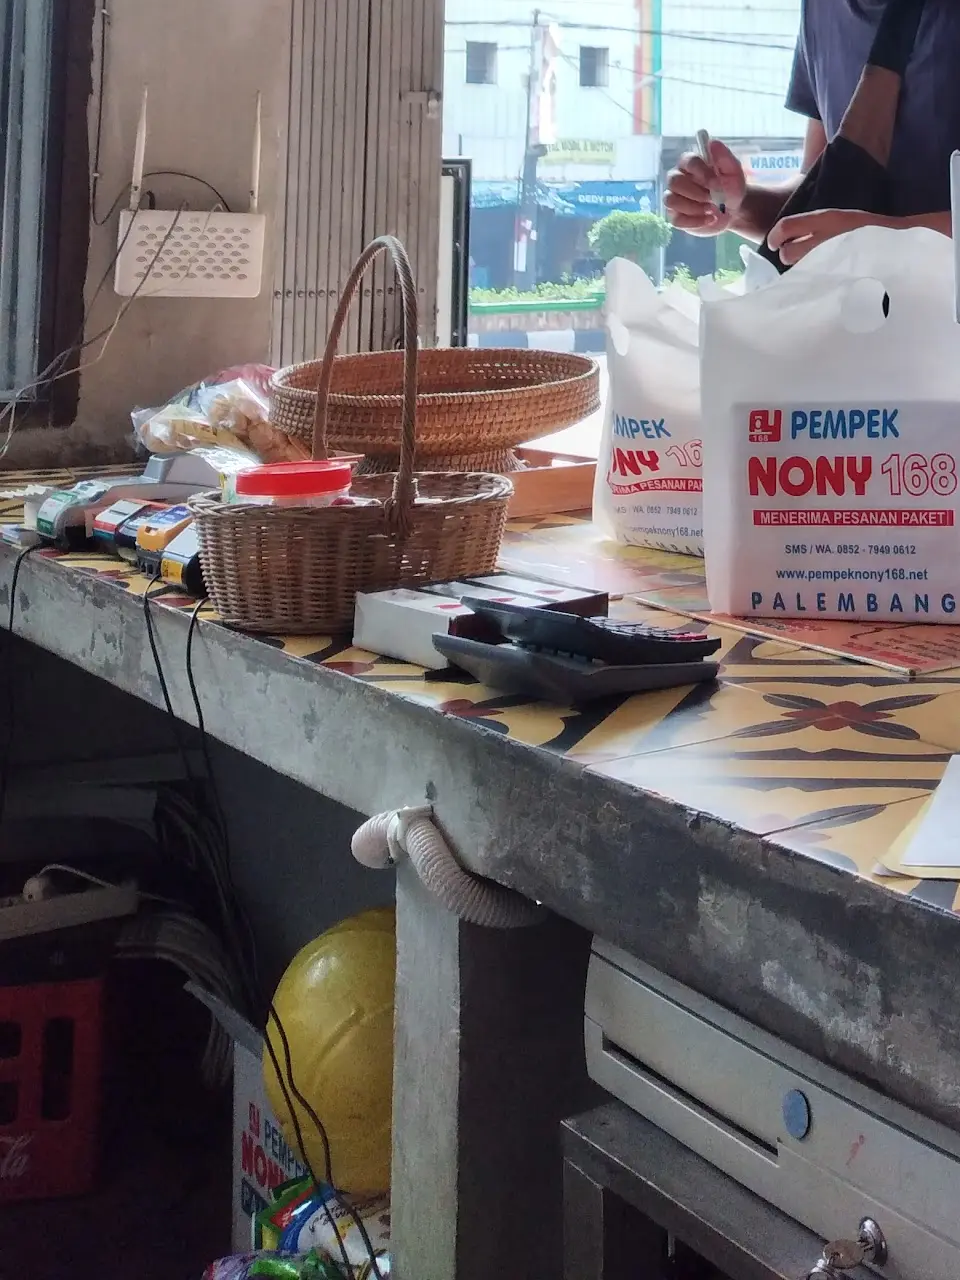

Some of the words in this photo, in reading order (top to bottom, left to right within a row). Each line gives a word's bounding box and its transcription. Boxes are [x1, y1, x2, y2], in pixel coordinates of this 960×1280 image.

[612, 410, 672, 439] MPEK
[791, 409, 900, 440] PEMPEK
[612, 447, 660, 477] NY
[665, 439, 703, 468] 16
[748, 456, 872, 497] NONY
[881, 453, 958, 496] 168
[640, 480, 686, 492] PESANAN
[760, 511, 831, 524] MENERIMA
[834, 511, 898, 524] PESANAN
[901, 511, 946, 524] PAKET
[785, 545, 807, 554] SMS
[815, 545, 834, 554] WA.
[837, 545, 860, 555] 0852
[868, 545, 891, 555] 7949
[893, 545, 917, 555] 0612
[776, 568, 928, 582] www.pempeknony168.net
[751, 592, 956, 613] PALEMBANG
